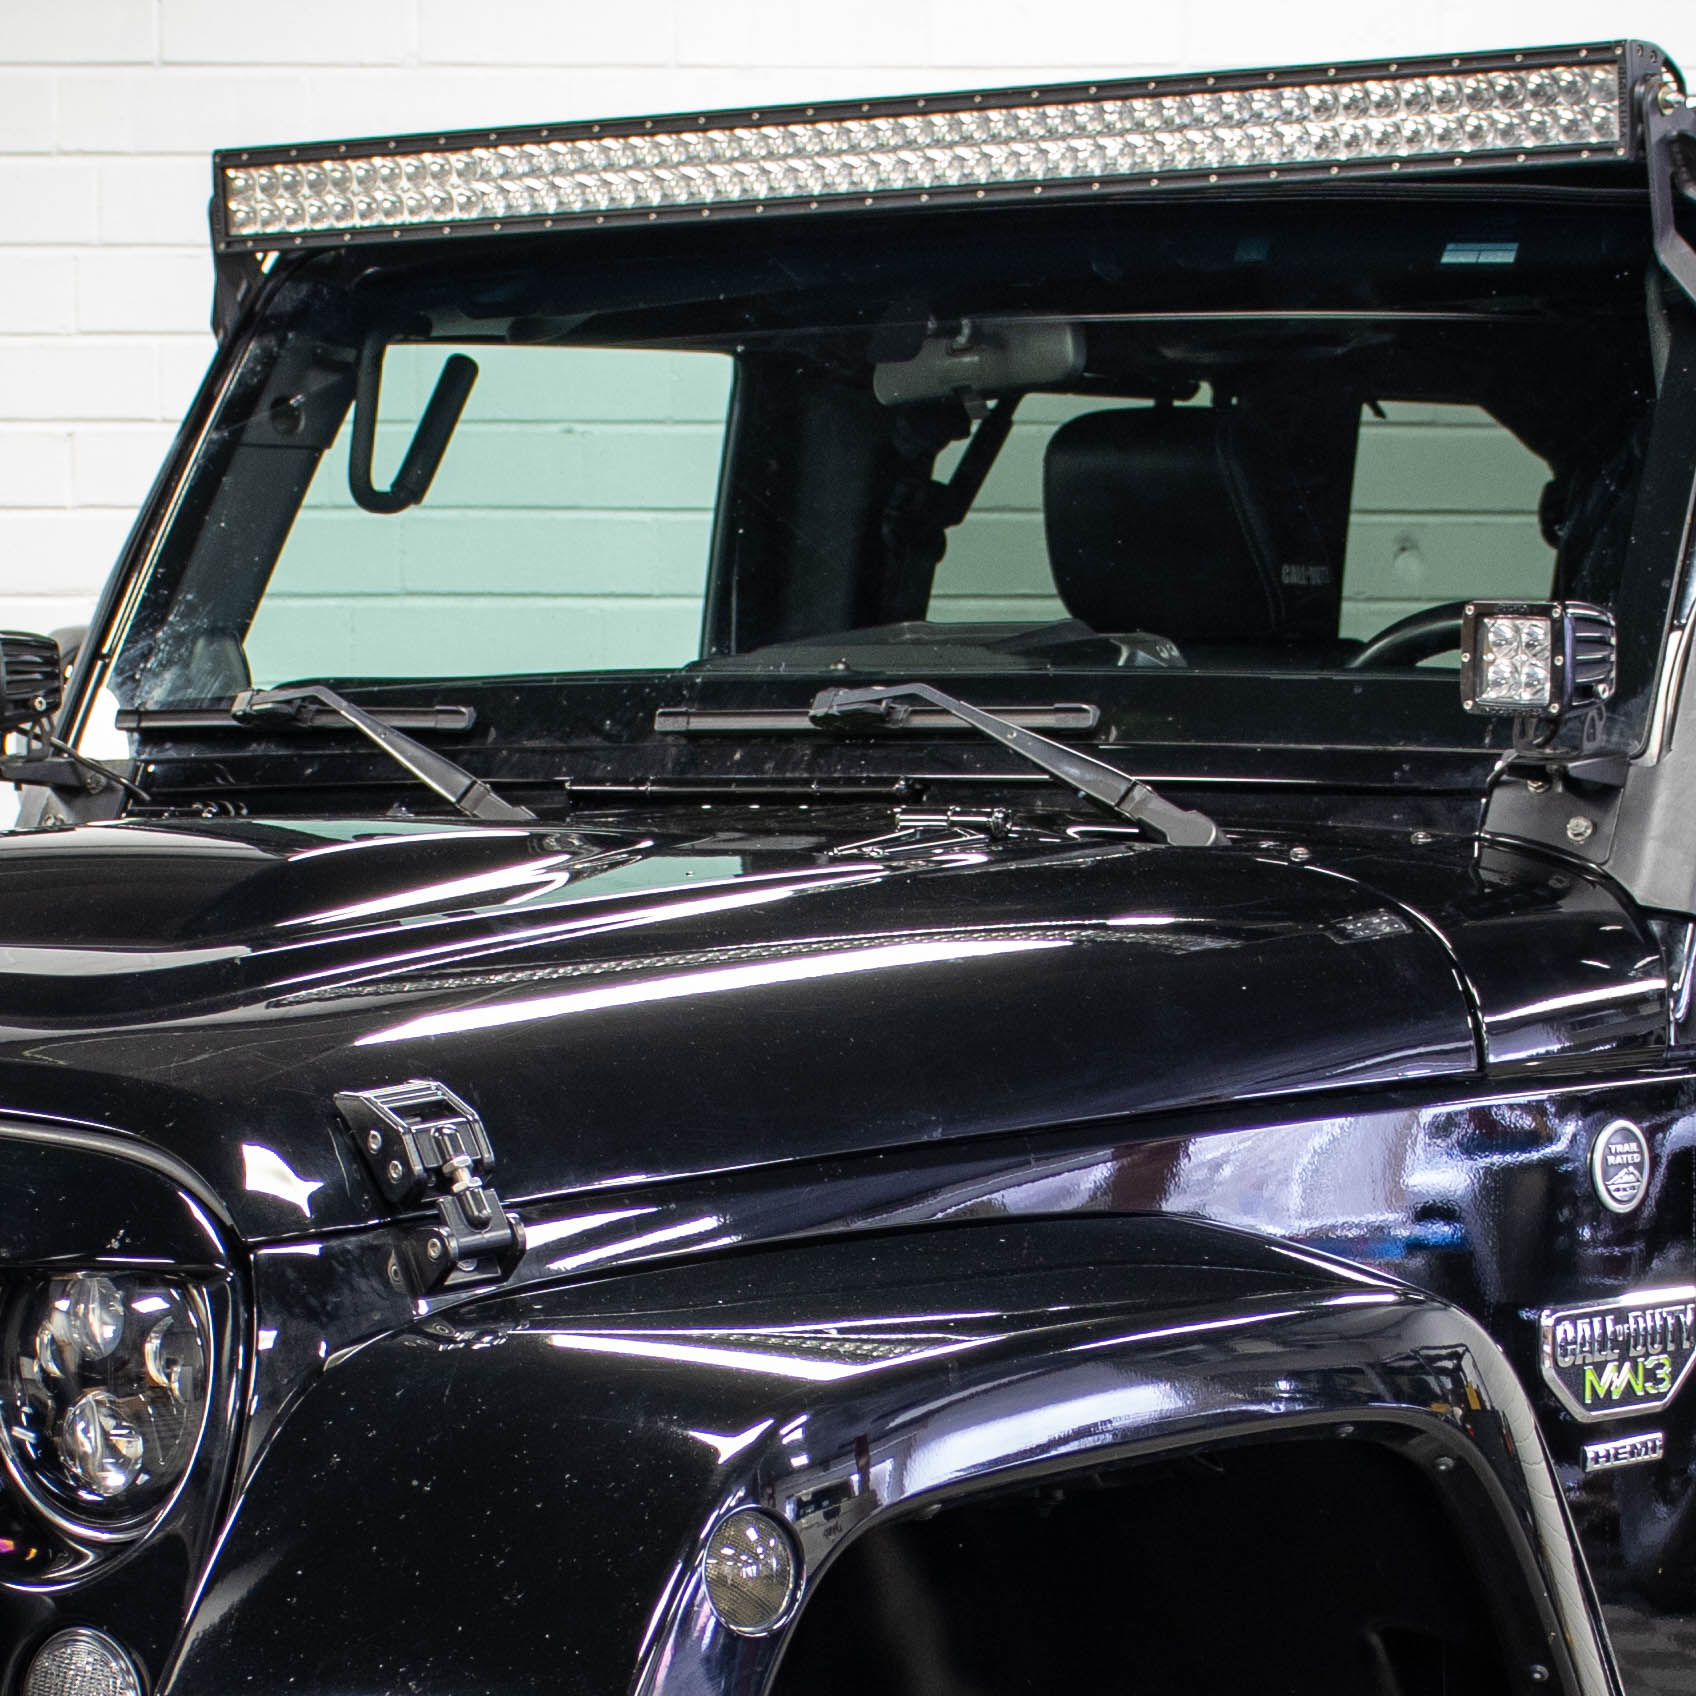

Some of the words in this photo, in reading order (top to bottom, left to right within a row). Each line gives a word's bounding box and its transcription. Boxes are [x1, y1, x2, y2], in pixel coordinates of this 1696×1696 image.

[1606, 1154, 1641, 1165] RATED
[1608, 1142, 1640, 1153] TRAIL
[1555, 1314, 1620, 1368] CALL
[1627, 1303, 1696, 1358] DUTY
[1584, 1354, 1672, 1404] MW3
[1586, 1438, 1663, 1469] HEMI
